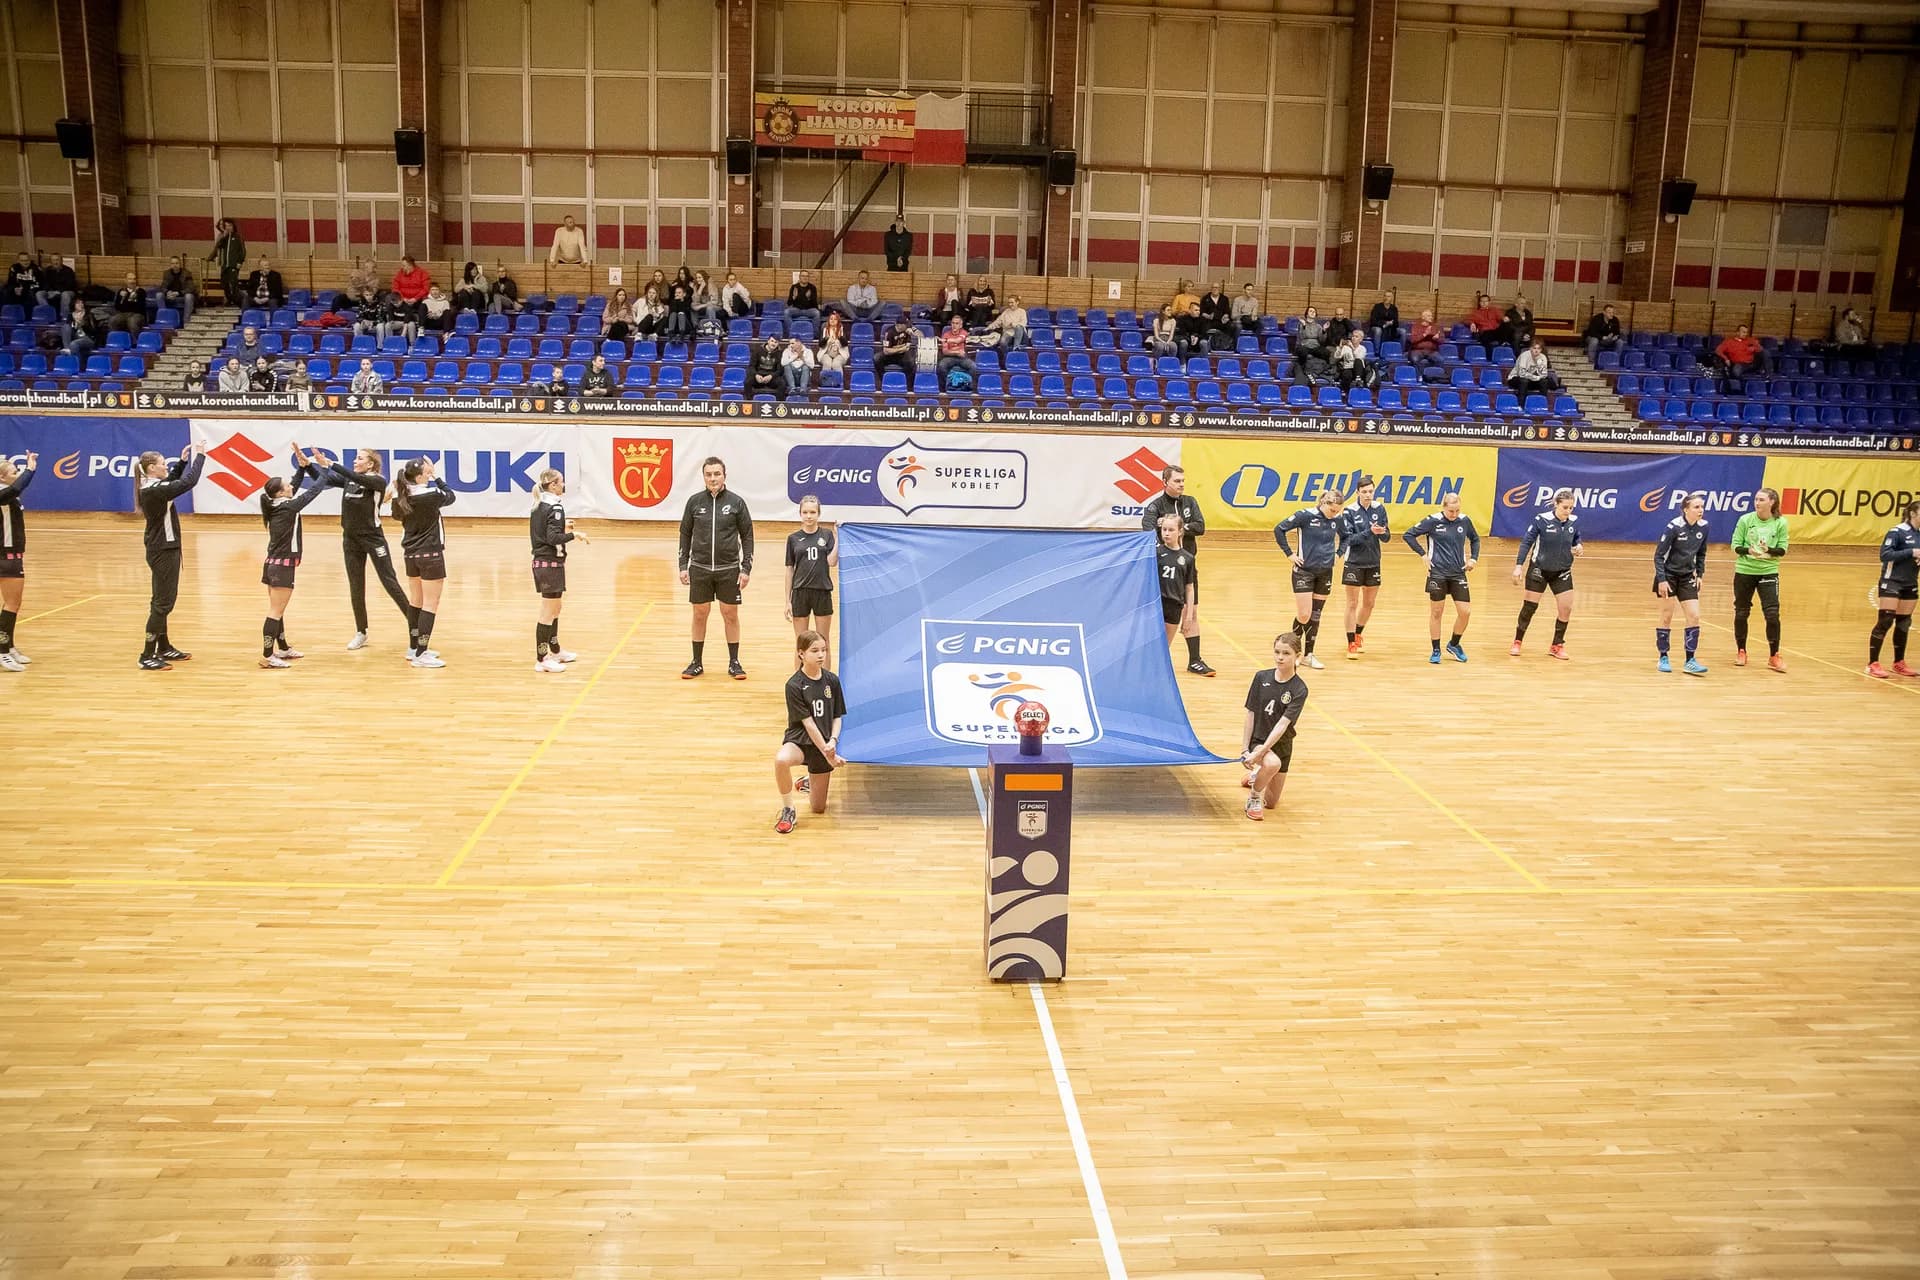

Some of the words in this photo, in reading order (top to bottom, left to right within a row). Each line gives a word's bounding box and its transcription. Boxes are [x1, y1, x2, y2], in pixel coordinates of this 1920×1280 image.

[816, 99, 898, 115] KORONA
[806, 115, 907, 132] HANDBALL
[834, 132, 881, 147] FANS
[0, 392, 101, 407] oronahandbal.pl
[377, 397, 516, 412] www.koronahandball.pl
[584, 400, 723, 415] www.koronahandball.pl
[791, 405, 930, 420] www.koronahandball.pl
[997, 409, 1133, 424] www.koronahandball.pl
[1198, 415, 1331, 430] www.koronahandball.pl
[1394, 420, 1522, 438] www.koronahandball.pl
[1582, 428, 1706, 444] www.koronahandball.pl
[1765, 433, 1887, 450] www.koronahandbal.pl
[814, 468, 872, 483] PGNiG
[934, 467, 1017, 479] SUPERLIGA
[620, 465, 661, 499] CK
[951, 481, 1000, 490] KOBIET
[1283, 469, 1464, 505] LEWATAN
[1799, 488, 1920, 517] KOLPOR
[806, 546, 818, 561] 10
[1162, 565, 1176, 580] 21
[973, 636, 1071, 656] PGNiG
[812, 699, 824, 717] 19
[1264, 699, 1276, 716] 4
[951, 724, 1080, 736] SUPEGA
